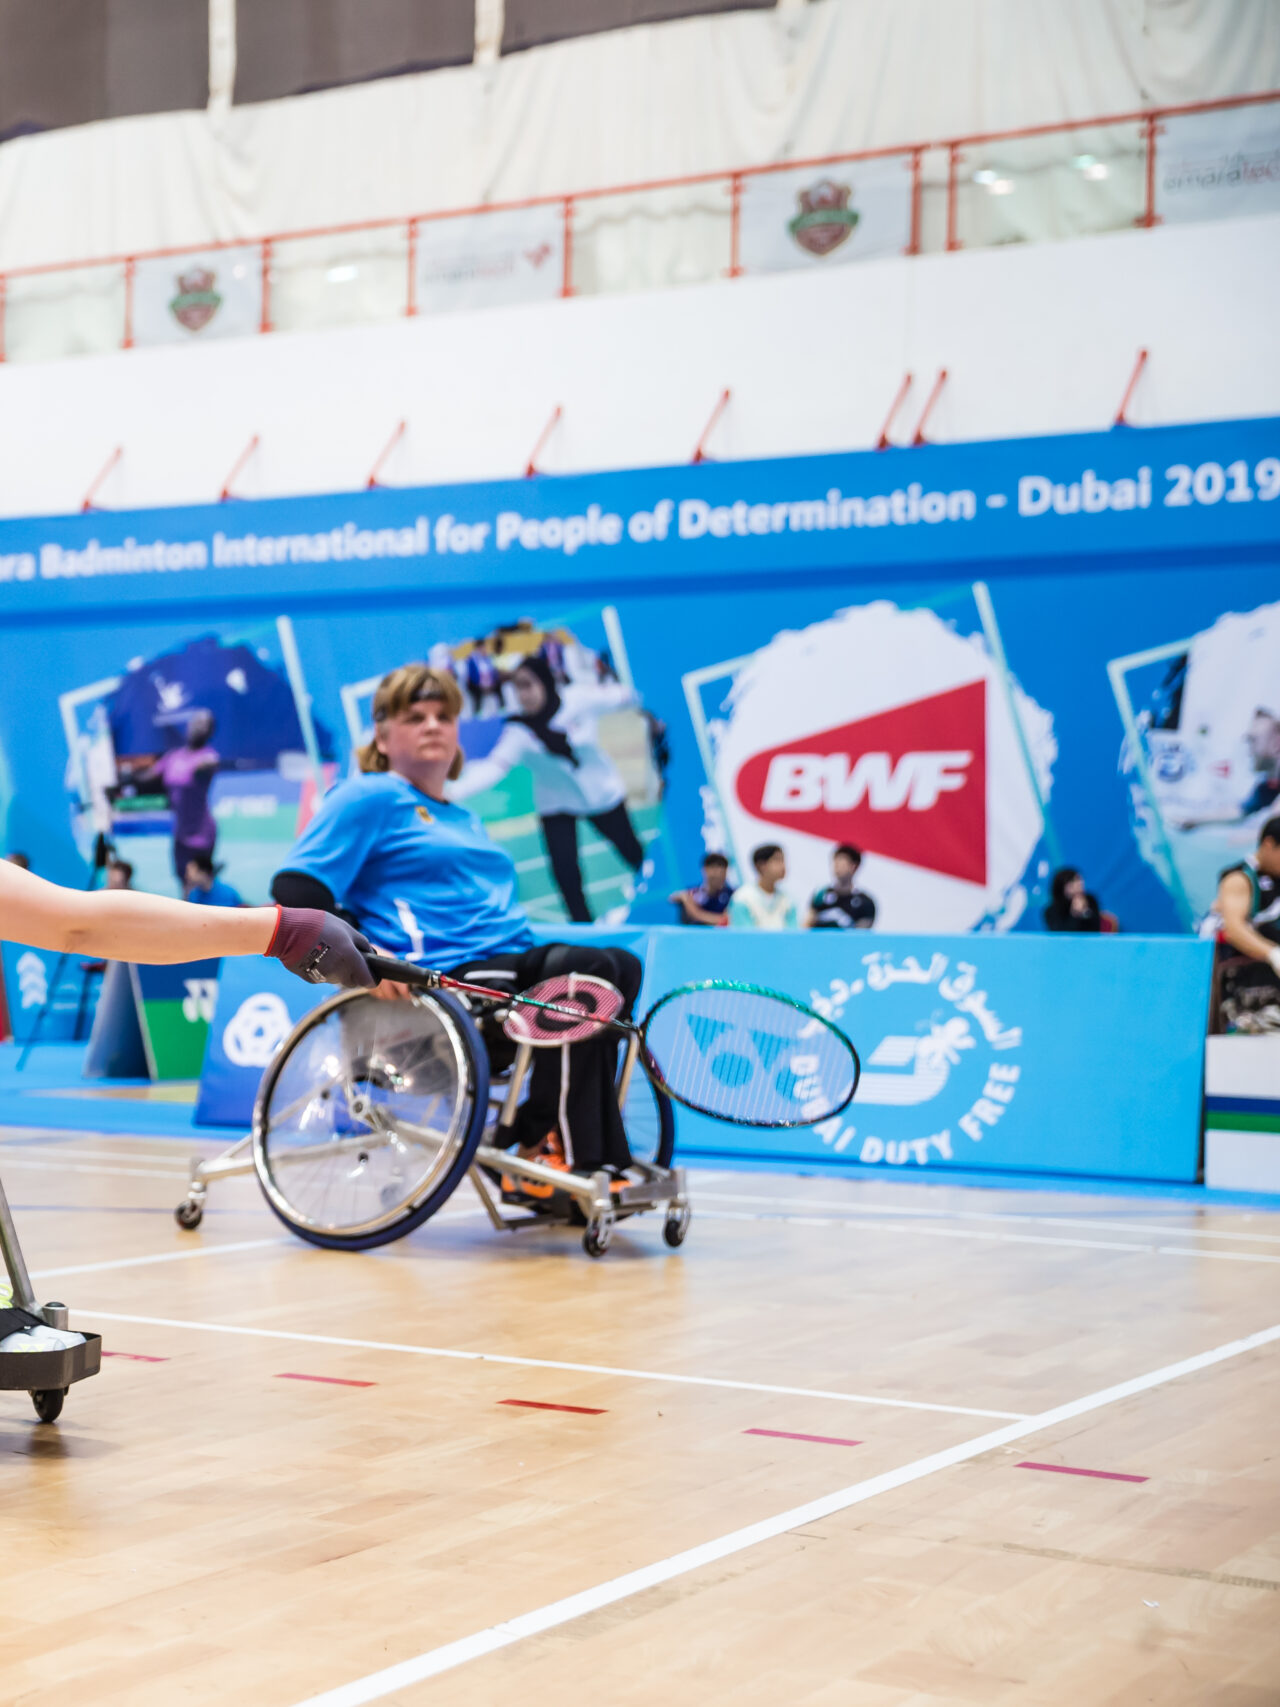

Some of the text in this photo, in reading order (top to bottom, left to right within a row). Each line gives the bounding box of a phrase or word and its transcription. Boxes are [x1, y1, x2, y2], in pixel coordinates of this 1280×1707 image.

[39, 536, 207, 579] Badminton
[213, 517, 430, 567] International
[433, 513, 487, 553] for
[496, 503, 622, 554] People
[628, 498, 674, 543] of
[678, 483, 977, 541] Determination
[1018, 466, 1152, 518] Dubai
[1165, 457, 1280, 509] 2019
[760, 749, 974, 813] BWF
[789, 1053, 1021, 1166] DUBAI DUTY FREE
